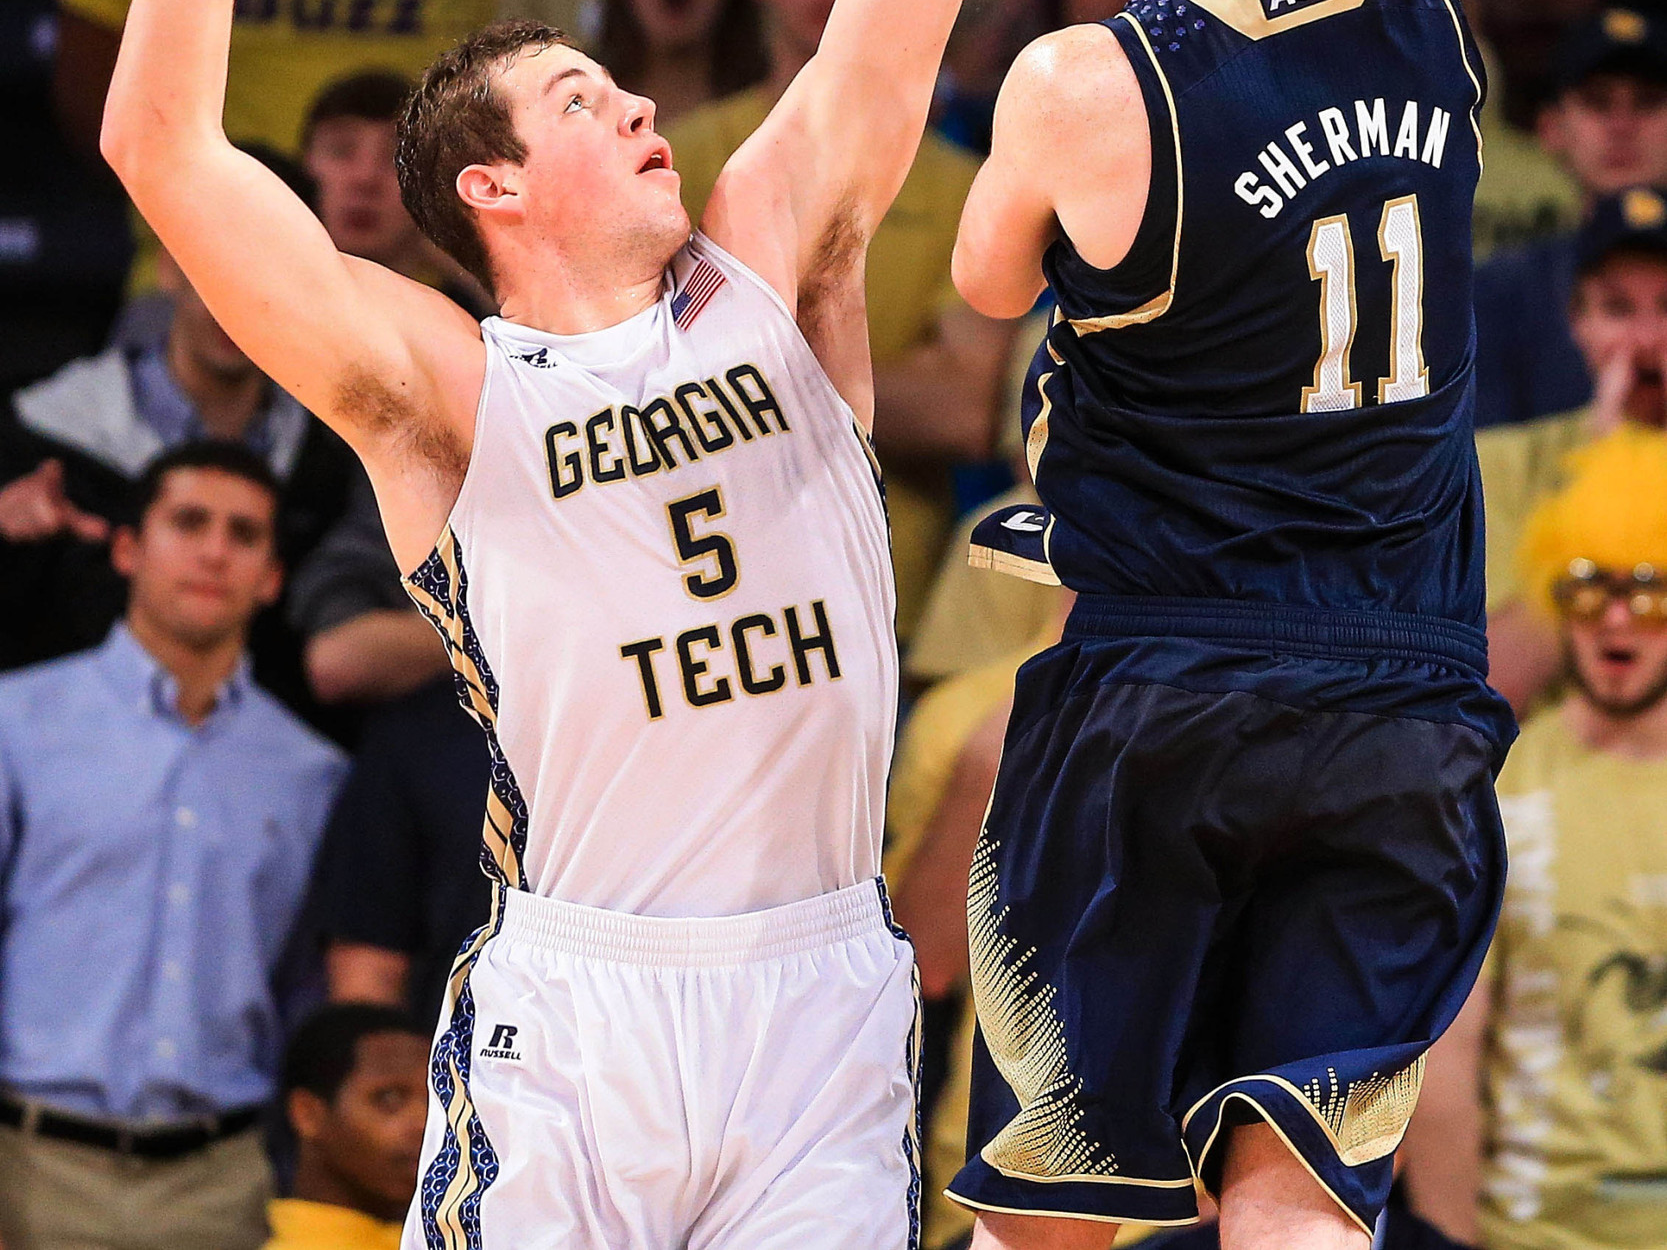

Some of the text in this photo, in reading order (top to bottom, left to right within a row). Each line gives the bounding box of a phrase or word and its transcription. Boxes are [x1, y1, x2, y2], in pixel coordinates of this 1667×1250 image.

[1233, 97, 1451, 219] SHERMAN
[1300, 193, 1431, 414] 11
[545, 363, 791, 500] GEORGIA
[666, 486, 741, 600] 5
[618, 599, 843, 721] TECH
[479, 1048, 521, 1061] RUSSELL
